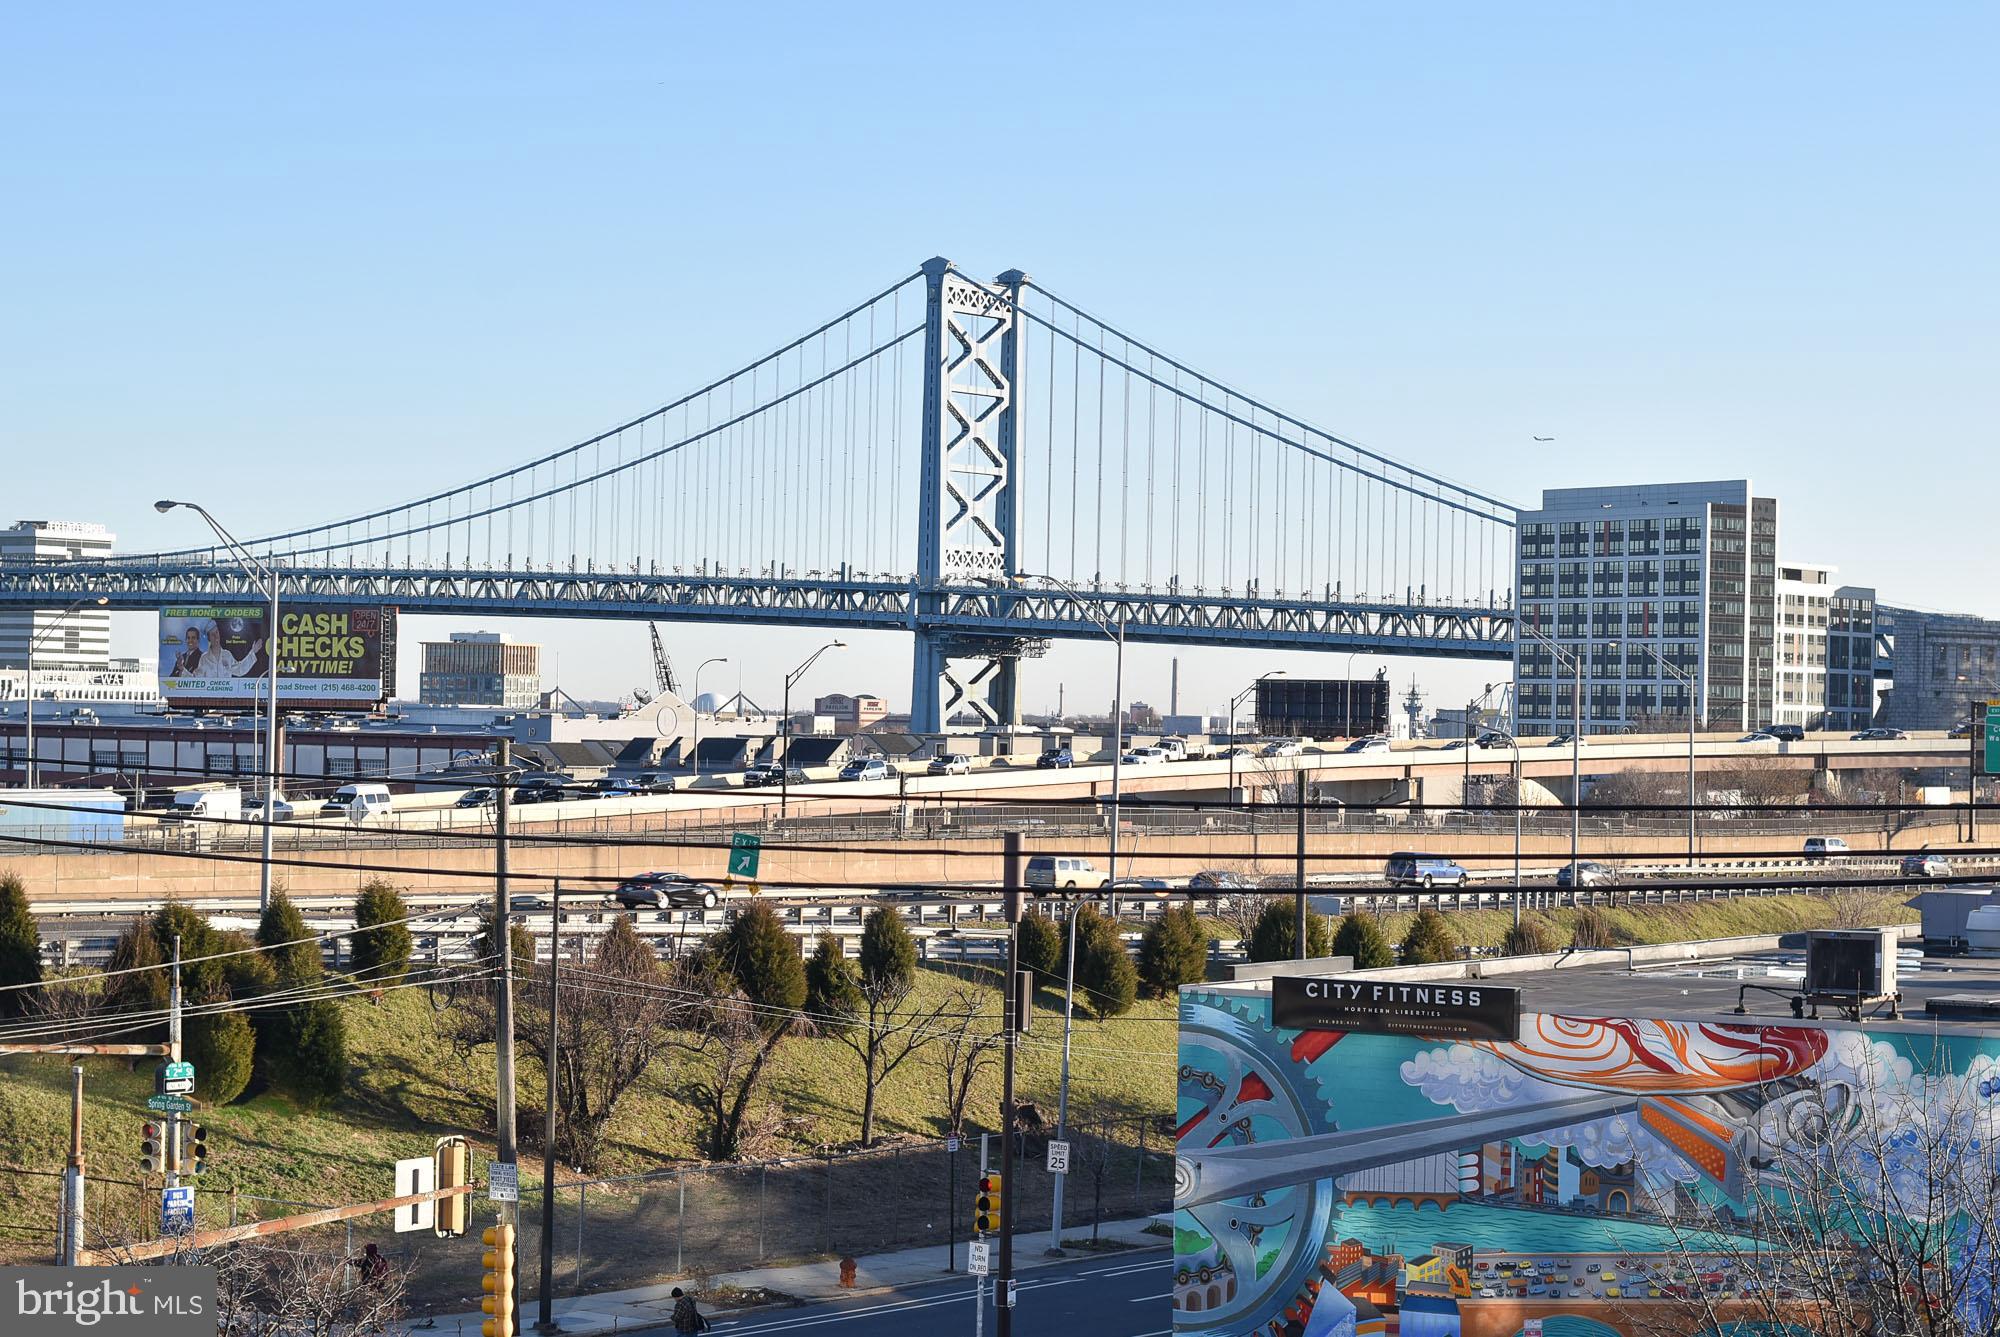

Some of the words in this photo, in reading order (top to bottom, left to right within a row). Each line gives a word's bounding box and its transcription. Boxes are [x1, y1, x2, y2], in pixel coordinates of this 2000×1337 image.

[165, 608, 188, 617] FREE
[190, 608, 223, 617] MONEY
[224, 608, 261, 617] ORDERS
[356, 610, 376, 620] OPEN
[282, 613, 348, 635] CASH
[265, 636, 365, 658] CHECKS
[275, 660, 353, 674] ANYTIME!
[177, 680, 206, 689] UNITED
[294, 683, 317, 691] Street
[321, 683, 338, 692] (215)
[734, 837, 758, 846] EXIT
[1305, 982, 1362, 1001] CITY
[1372, 985, 1481, 1007] FITNESS
[1344, 1006, 1390, 1015] NORTHERN
[1395, 1009, 1441, 1017] LIBERTIES
[148, 1099, 165, 1110] Spring
[166, 1100, 185, 1111] Garden
[185, 1102, 192, 1111] St
[1050, 1157, 1065, 1169] 25
[972, 1254, 986, 1262] TURN
